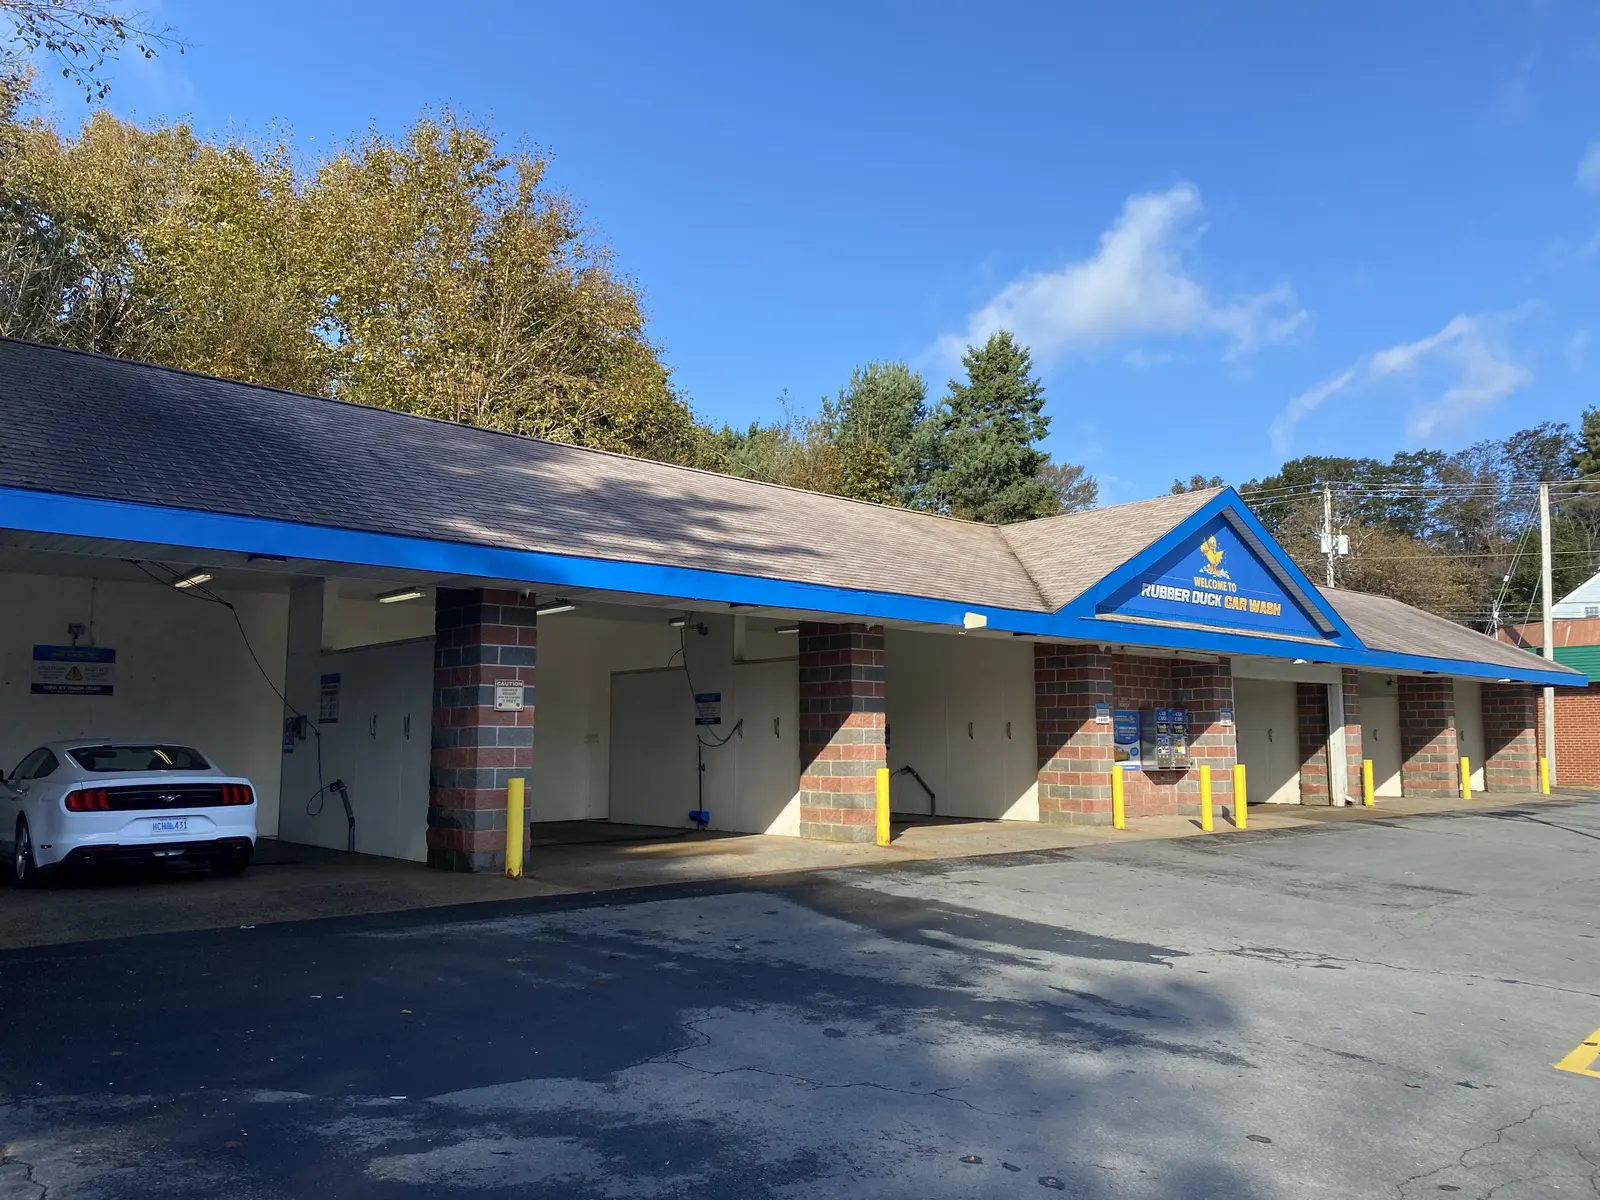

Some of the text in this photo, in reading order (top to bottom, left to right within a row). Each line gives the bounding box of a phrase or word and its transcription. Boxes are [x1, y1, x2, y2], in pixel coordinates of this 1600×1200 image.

[1193, 576, 1237, 592] WELCOME TO
[1141, 582, 1281, 616] RUBBER DUCK CAR WASH
[152, 820, 187, 831] HCH 431
